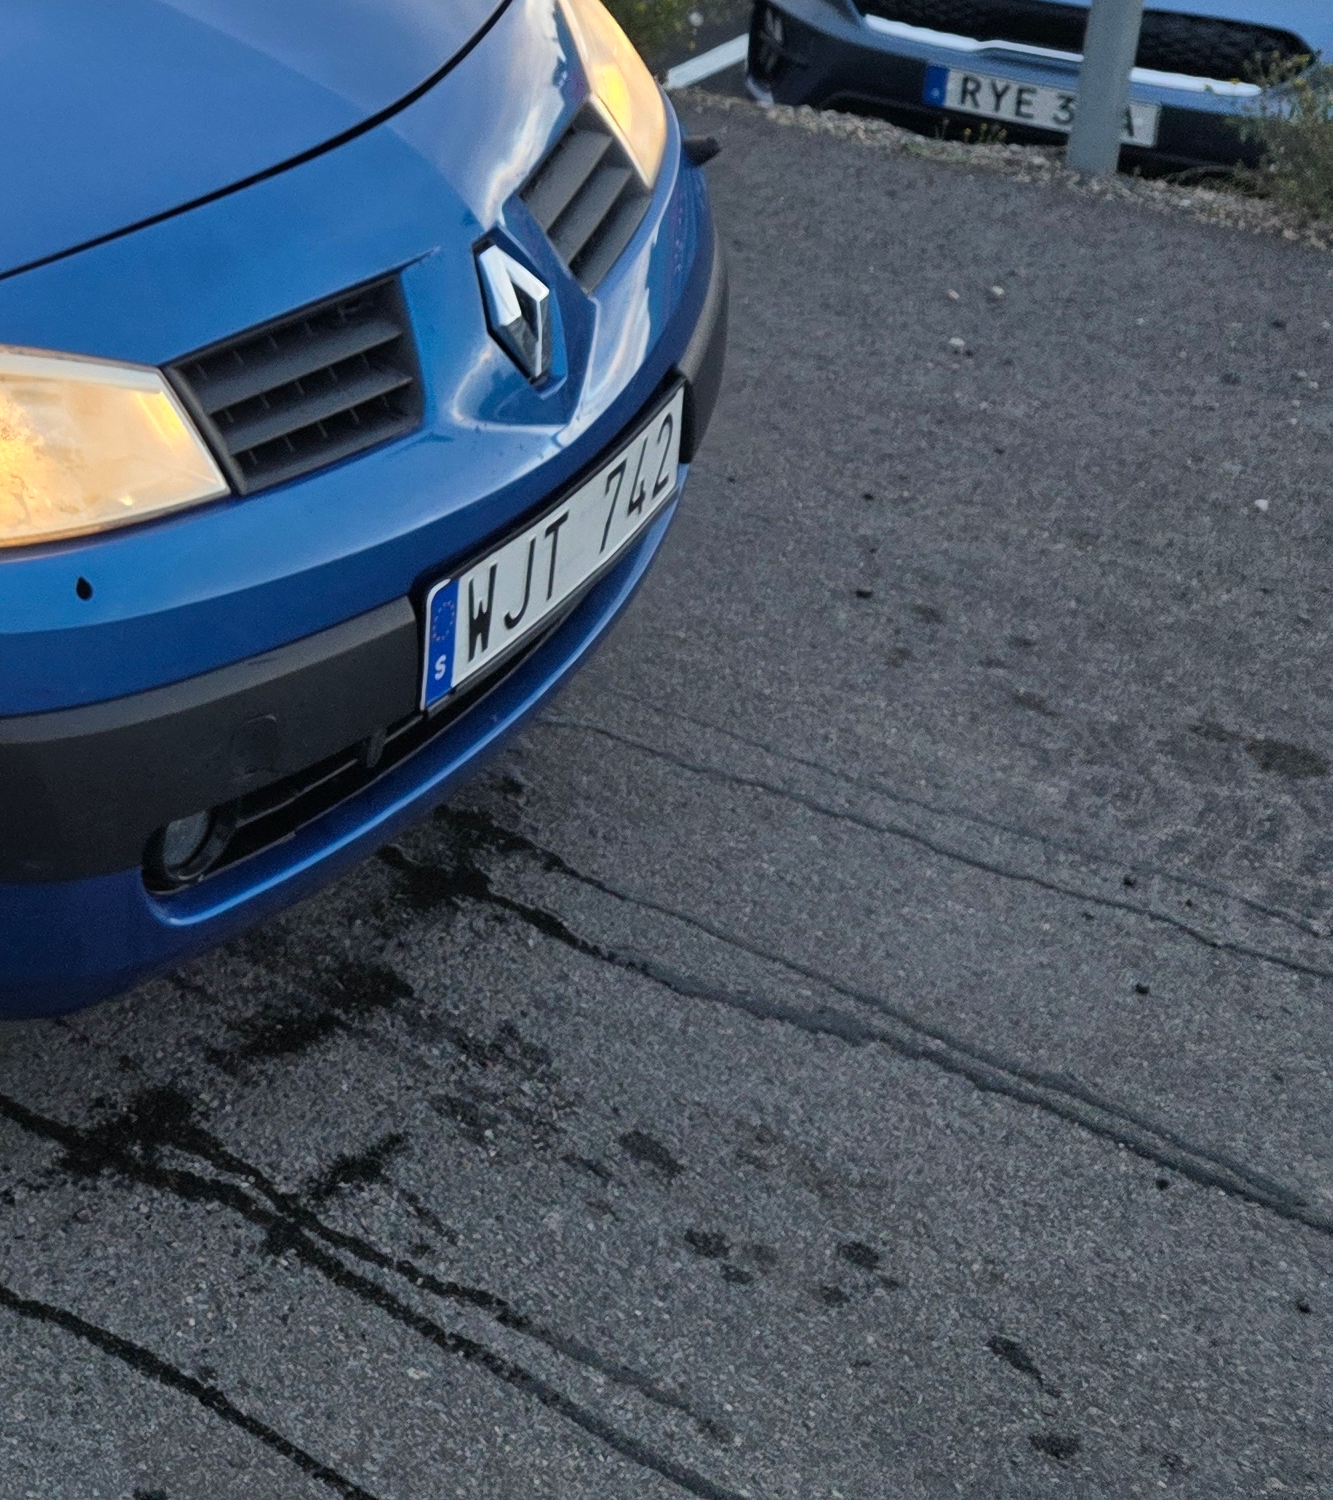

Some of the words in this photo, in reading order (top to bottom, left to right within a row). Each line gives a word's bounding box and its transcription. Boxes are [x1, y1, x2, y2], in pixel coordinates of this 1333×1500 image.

[960, 75, 1037, 120] RYE
[468, 510, 569, 663] WJT
[599, 412, 674, 555] 742
[434, 653, 447, 681] S
